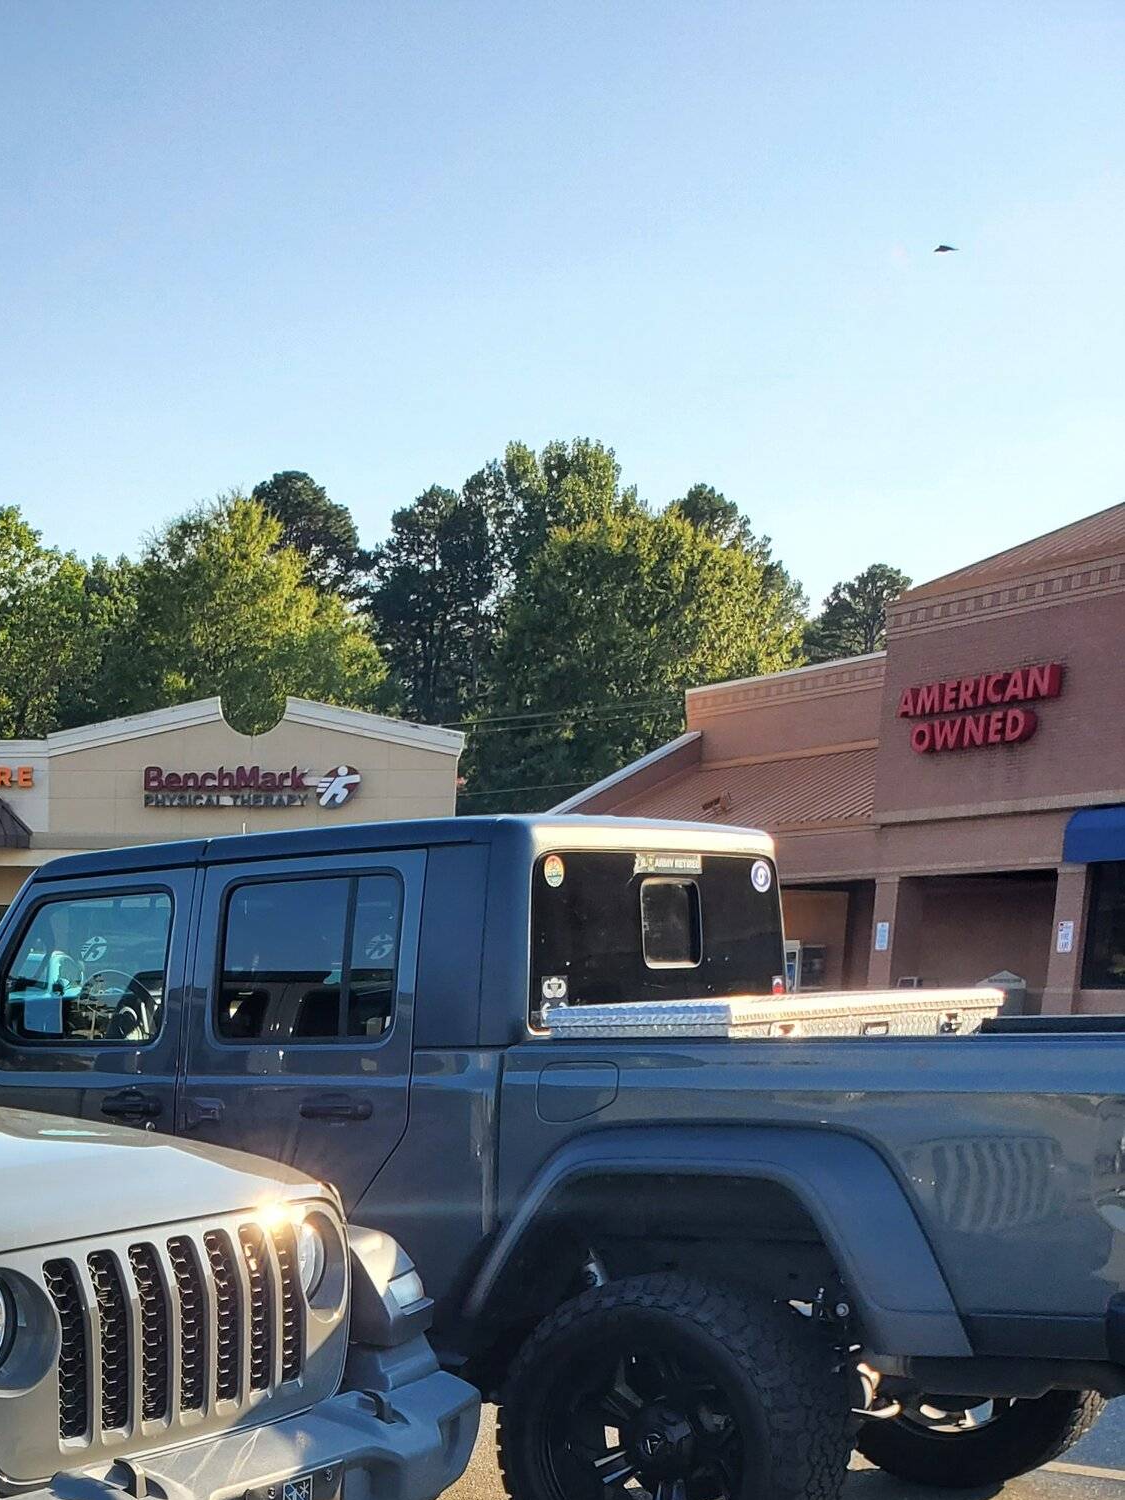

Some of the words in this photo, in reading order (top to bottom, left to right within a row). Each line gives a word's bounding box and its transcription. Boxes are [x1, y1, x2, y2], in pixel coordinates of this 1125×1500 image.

[896, 663, 1057, 718] AMERICAN
[910, 708, 1030, 755] OWNED
[144, 766, 308, 791] BenchMark
[144, 793, 222, 808] PHYSICAL
[231, 793, 309, 808] THERAPY
